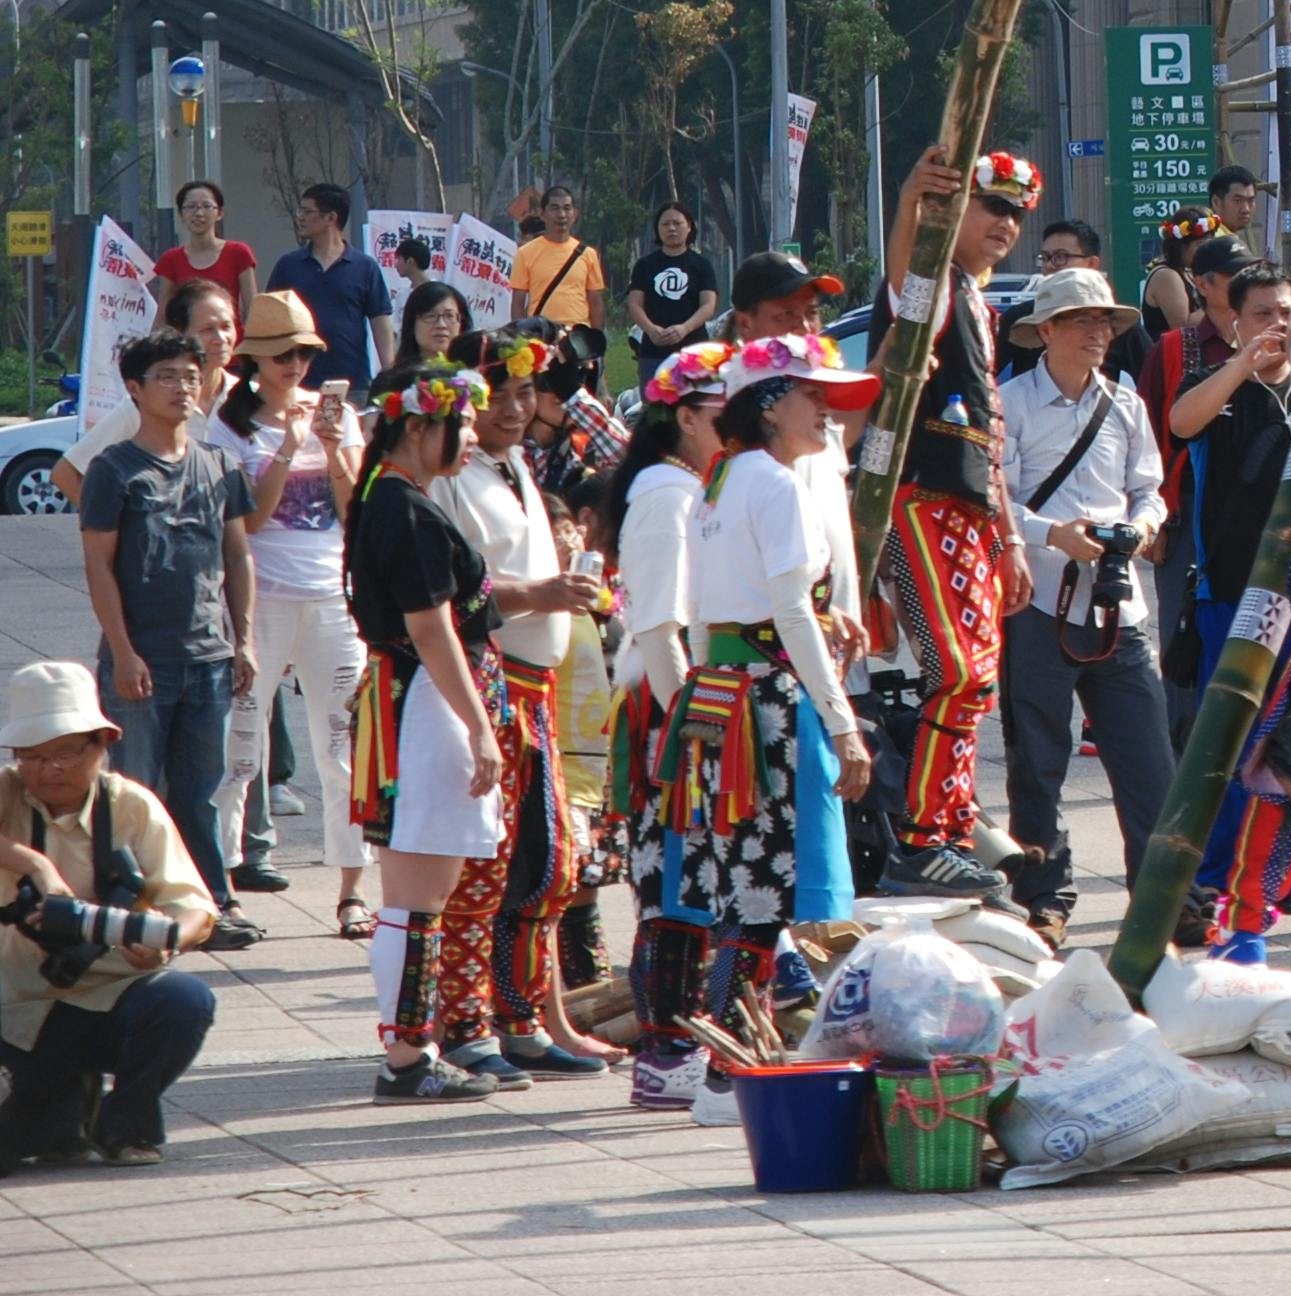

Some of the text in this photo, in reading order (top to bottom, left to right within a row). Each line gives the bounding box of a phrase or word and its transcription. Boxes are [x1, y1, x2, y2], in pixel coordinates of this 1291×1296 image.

[1149, 41, 1184, 79] P
[1130, 110, 1206, 126] 地下停車場
[1152, 159, 1191, 178] 150
[1155, 199, 1182, 218] 30
